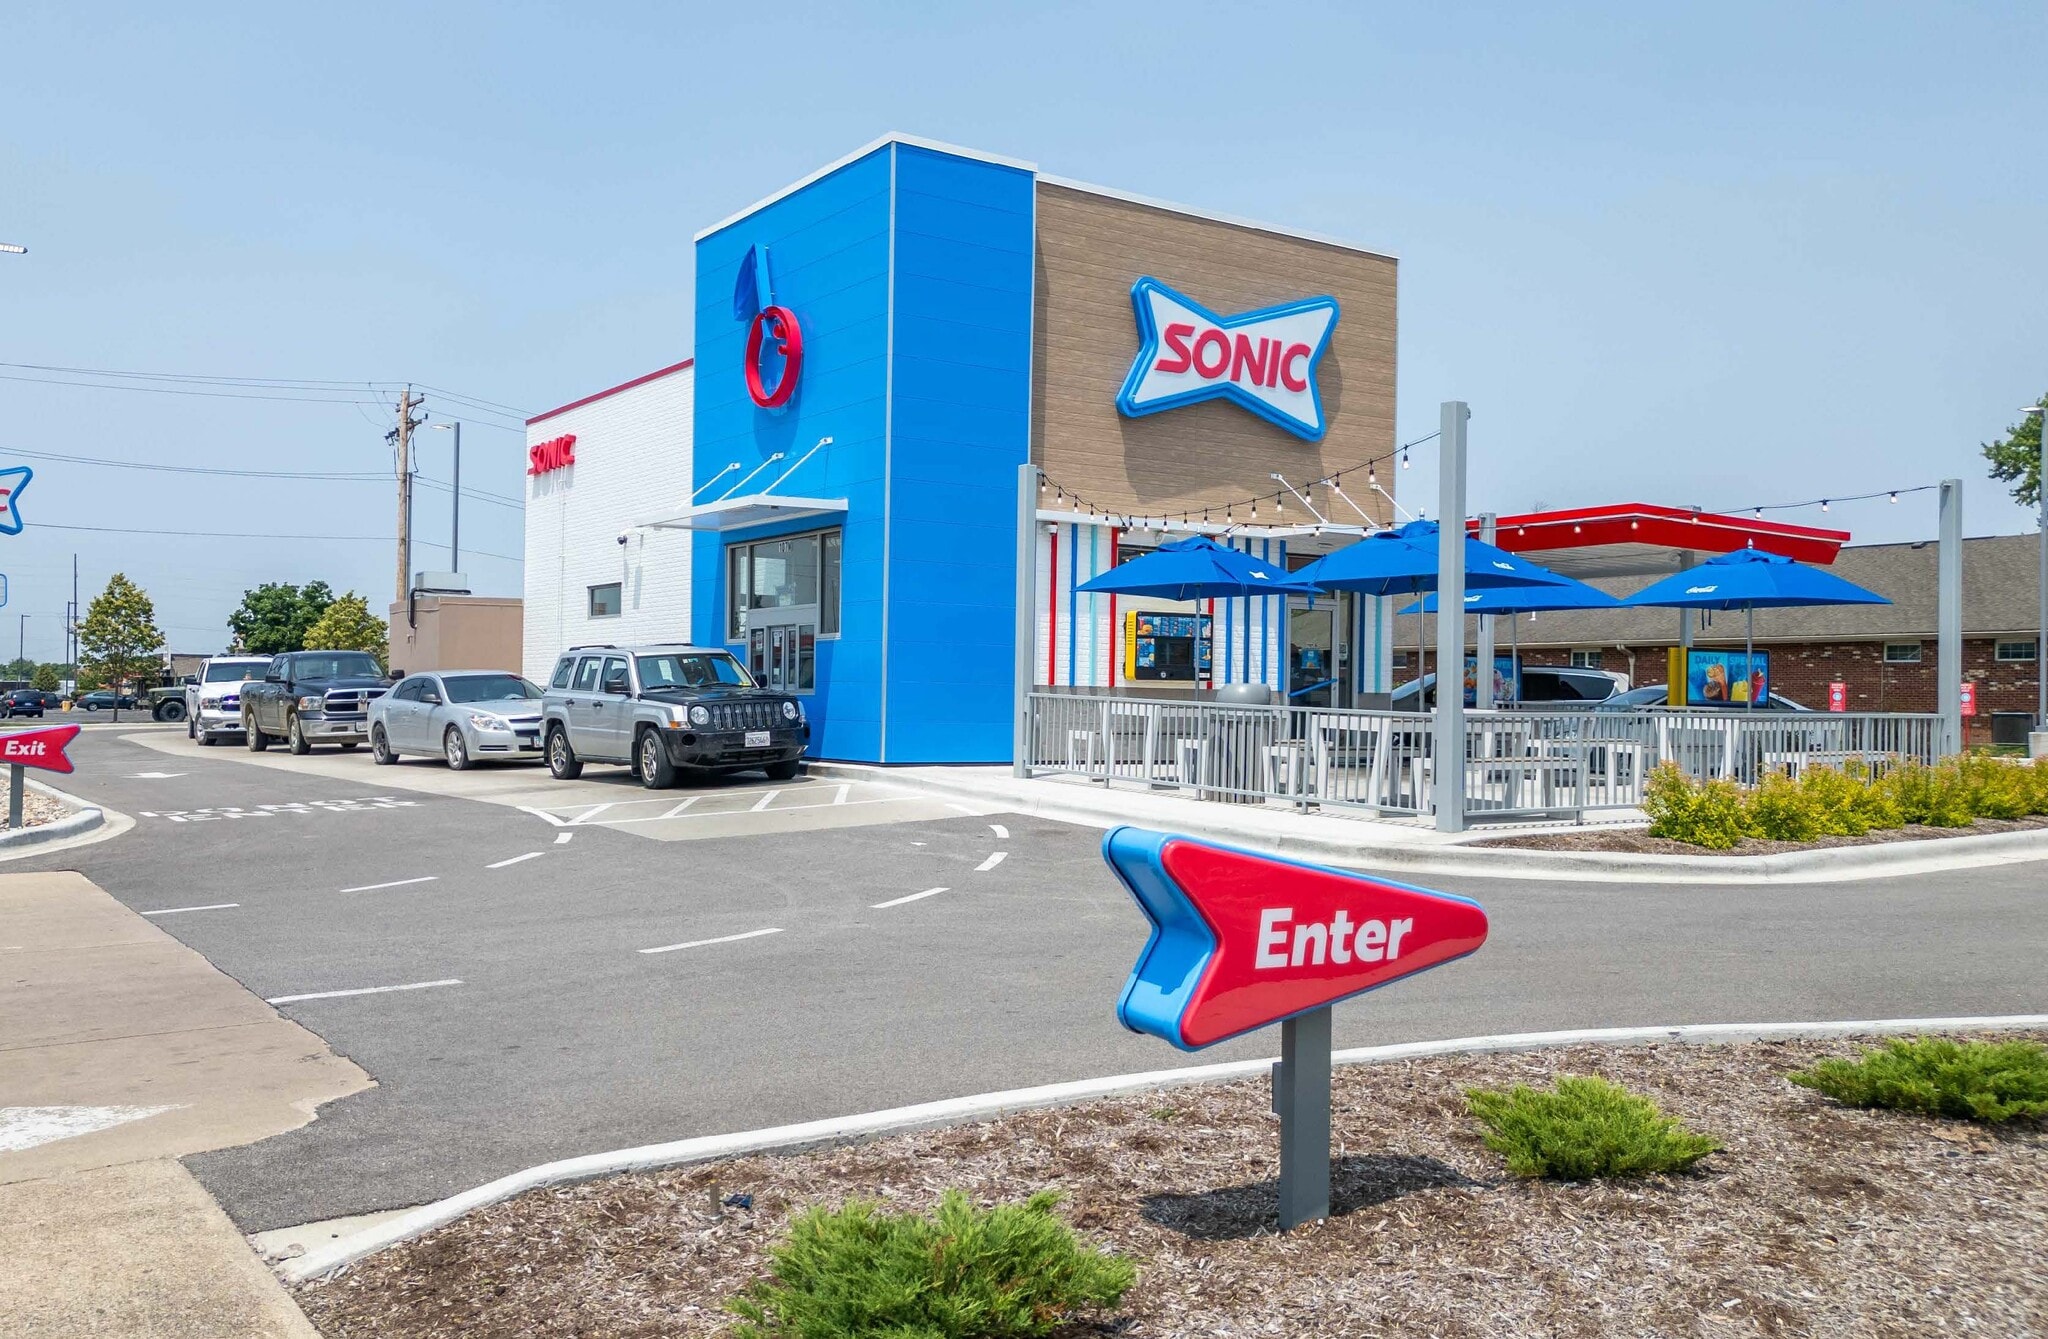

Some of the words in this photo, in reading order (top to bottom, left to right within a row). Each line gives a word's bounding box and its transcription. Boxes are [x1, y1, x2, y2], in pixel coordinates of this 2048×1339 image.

[1154, 322, 1311, 393] SONIC
[527, 433, 577, 476] SONIC
[1695, 655, 1720, 664] DAILY
[1729, 656, 1766, 666] SPEIAL
[4, 740, 47, 756] Exit
[1254, 907, 1414, 970] Enter
